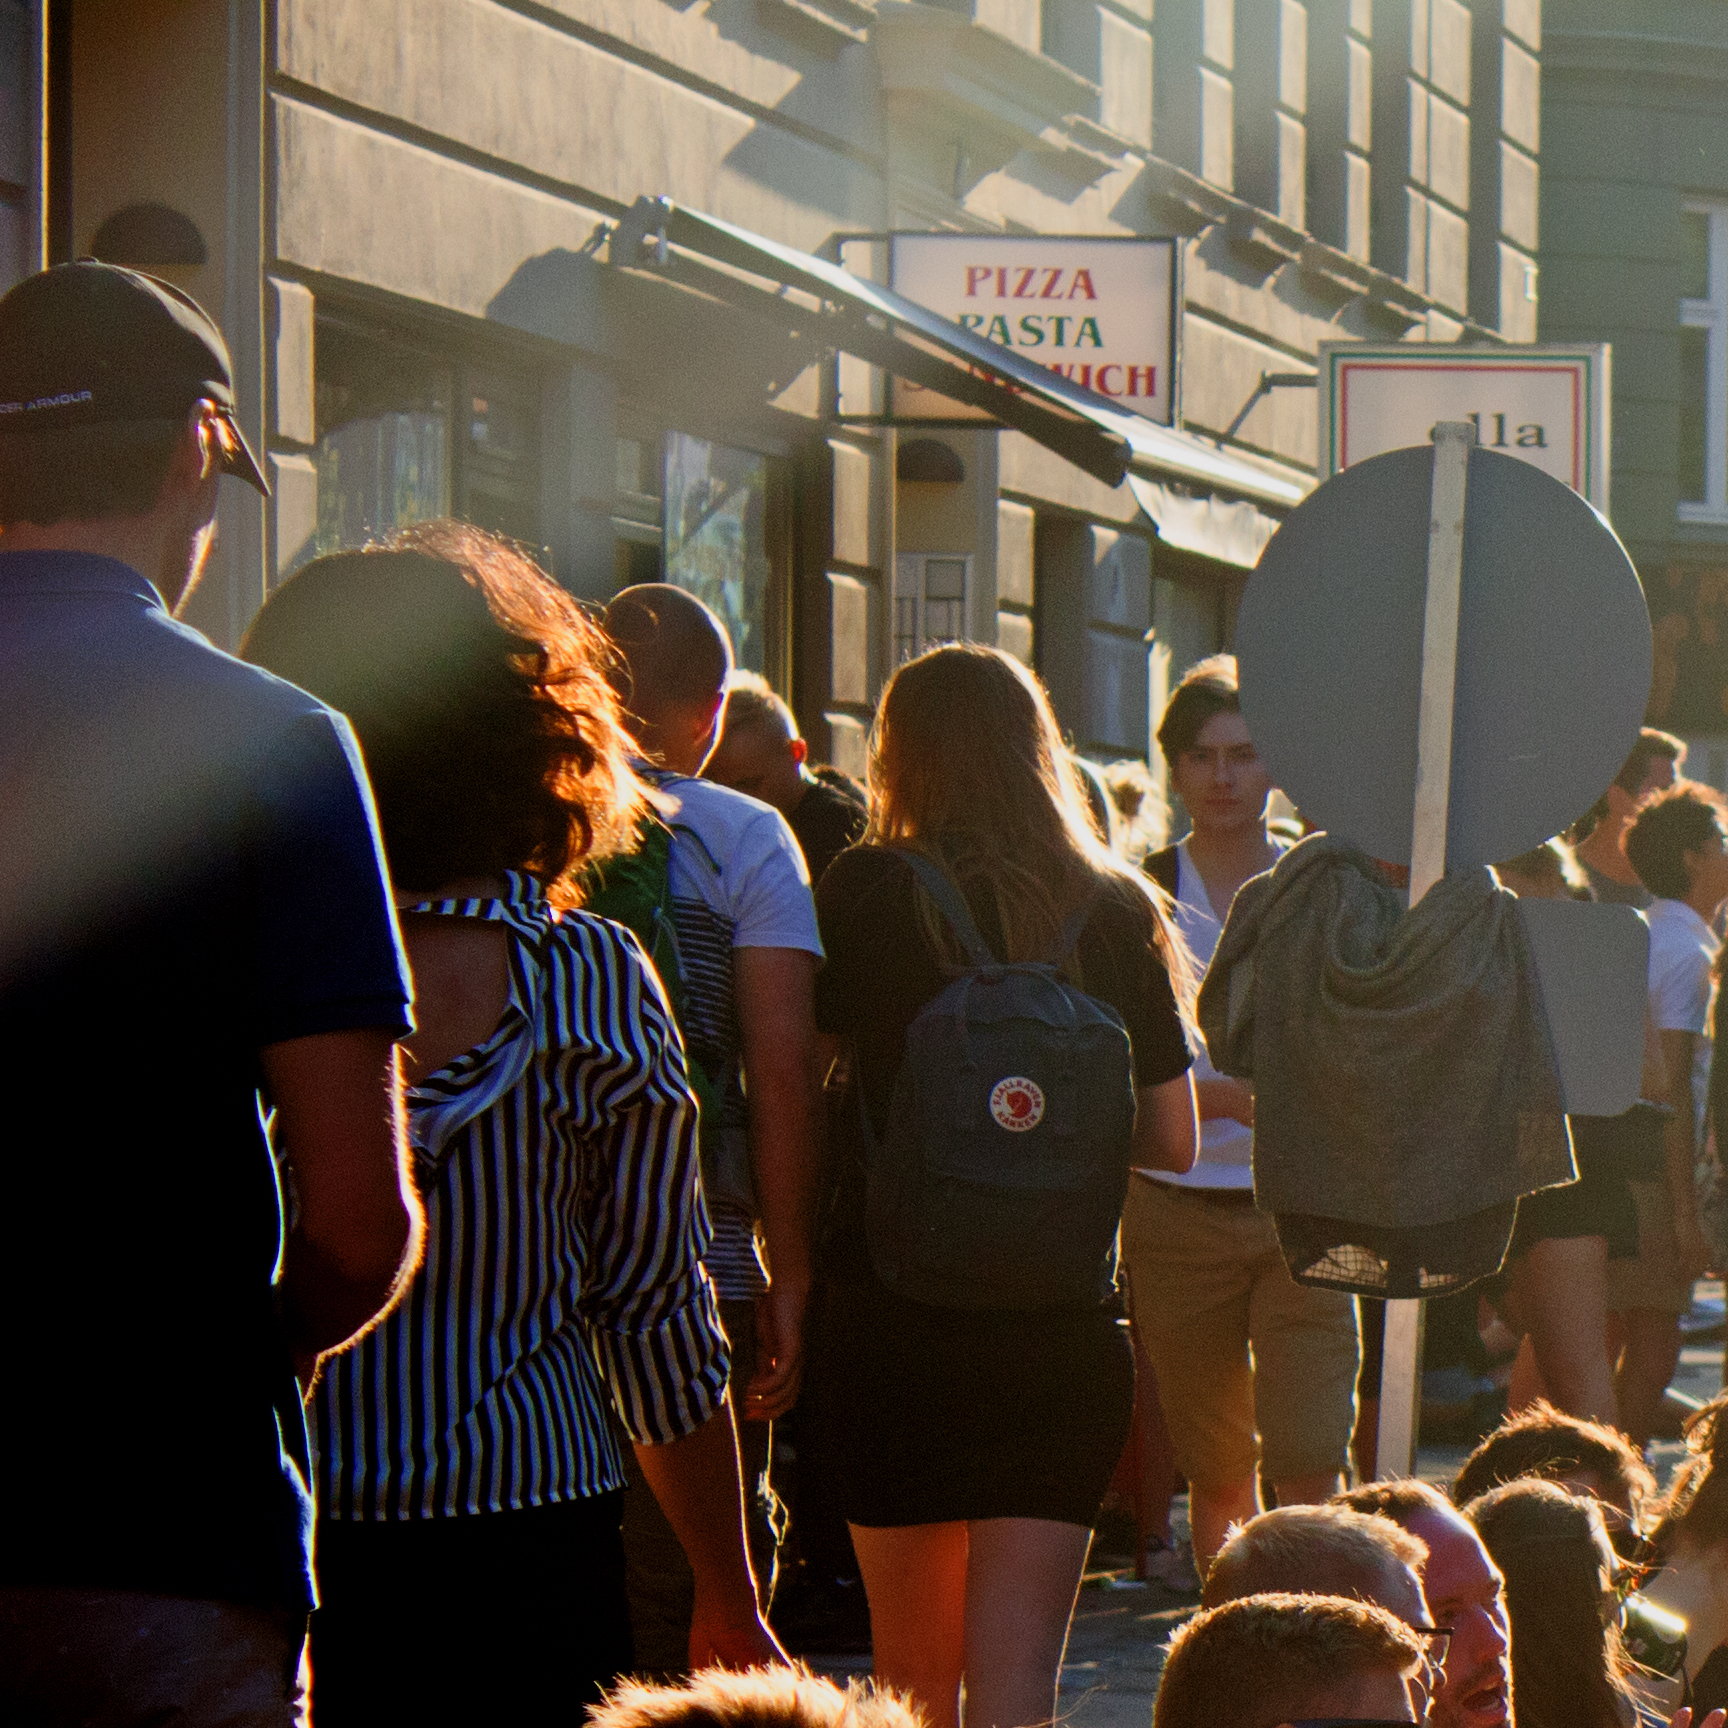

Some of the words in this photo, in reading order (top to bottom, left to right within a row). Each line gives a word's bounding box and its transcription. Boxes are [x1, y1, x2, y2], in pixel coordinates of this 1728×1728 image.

[965, 265, 1097, 300] PIZZA
[958, 313, 1103, 349] PASTA
[1429, 412, 1548, 448] lla
